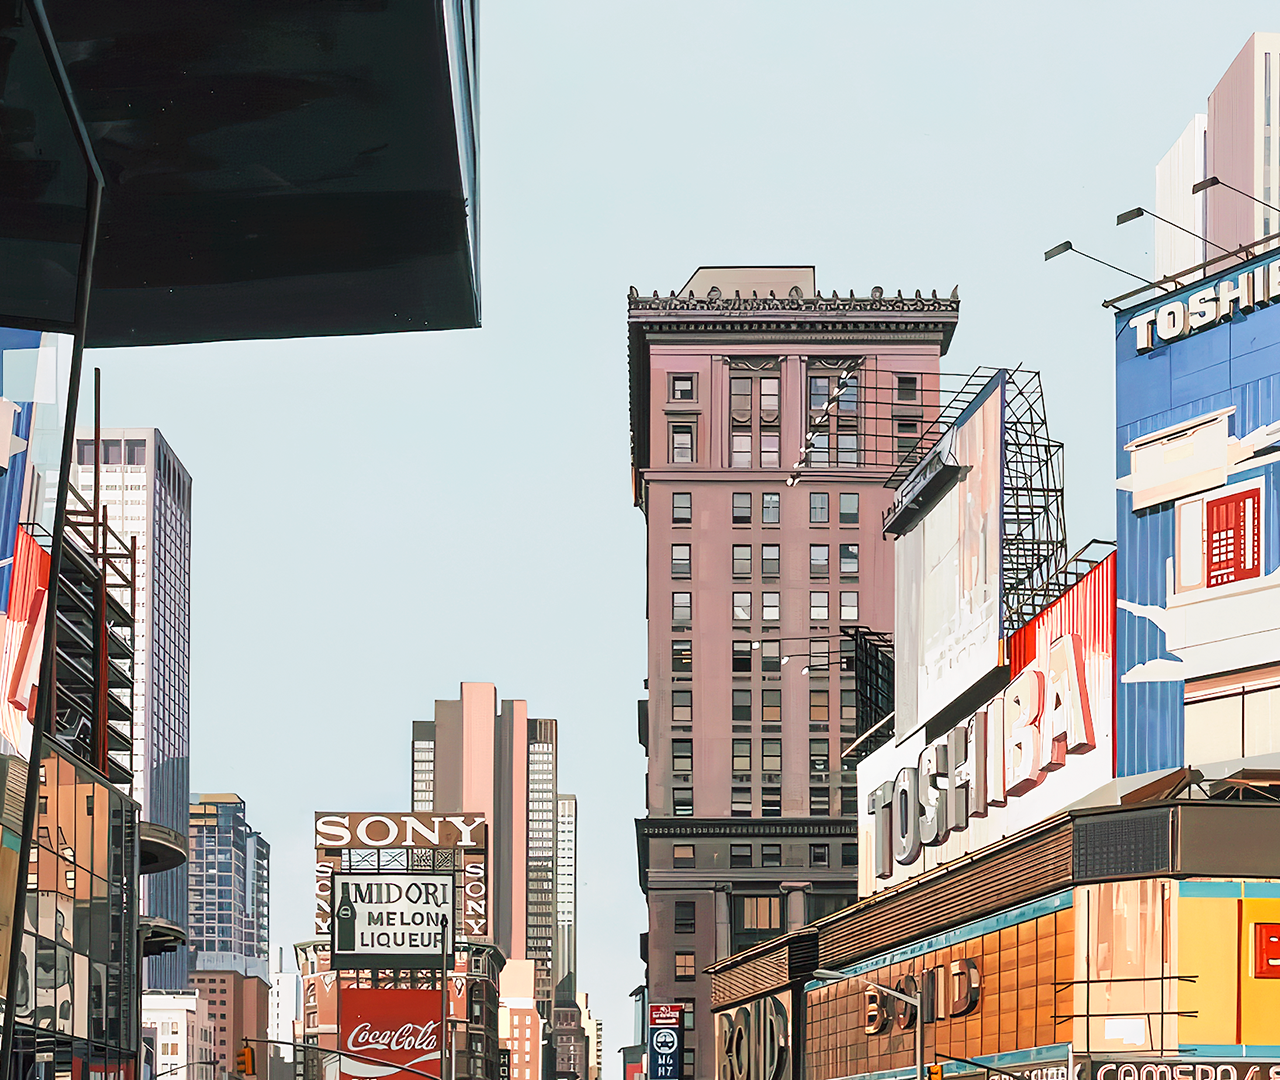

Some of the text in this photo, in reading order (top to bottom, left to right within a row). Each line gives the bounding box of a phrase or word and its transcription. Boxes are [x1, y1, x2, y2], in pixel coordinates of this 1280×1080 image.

[867, 632, 1096, 880] TOSHIBA
[315, 814, 486, 847] SONY
[351, 881, 450, 909] MIDORI
[464, 862, 487, 935] SONY
[367, 911, 440, 927] MELON
